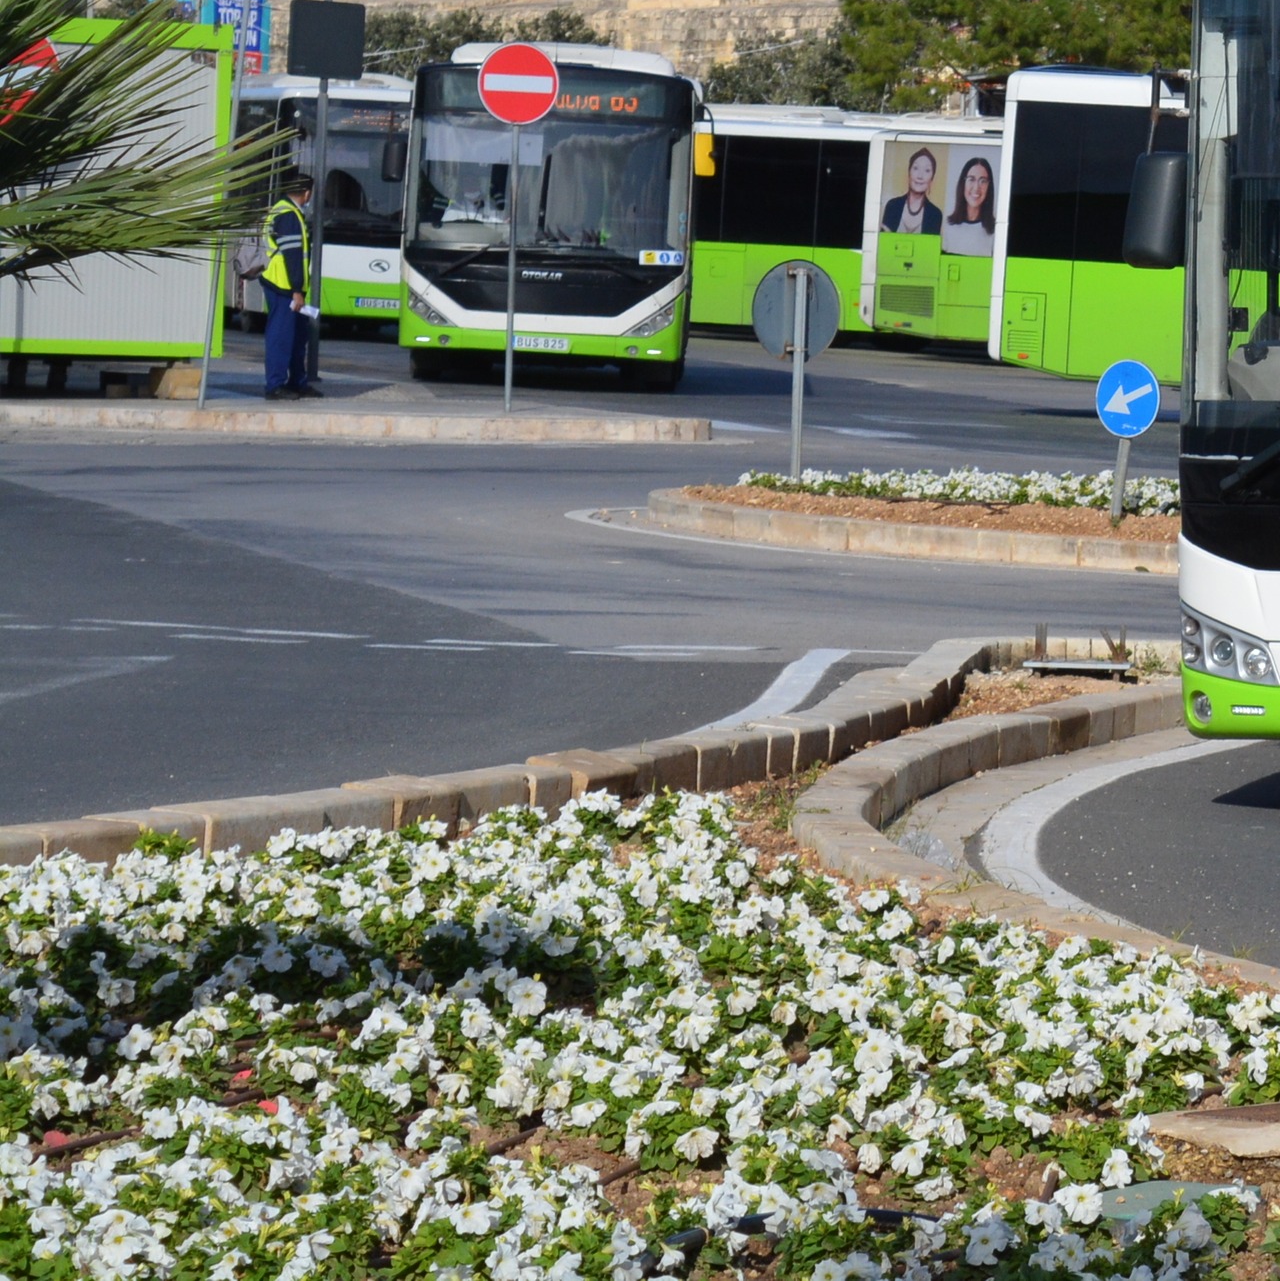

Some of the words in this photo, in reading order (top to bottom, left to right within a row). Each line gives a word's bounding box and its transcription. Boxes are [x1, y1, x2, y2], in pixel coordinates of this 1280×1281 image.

[521, 270, 563, 281] OTOKAR
[516, 337, 539, 348] BUS
[543, 338, 565, 349] 825
